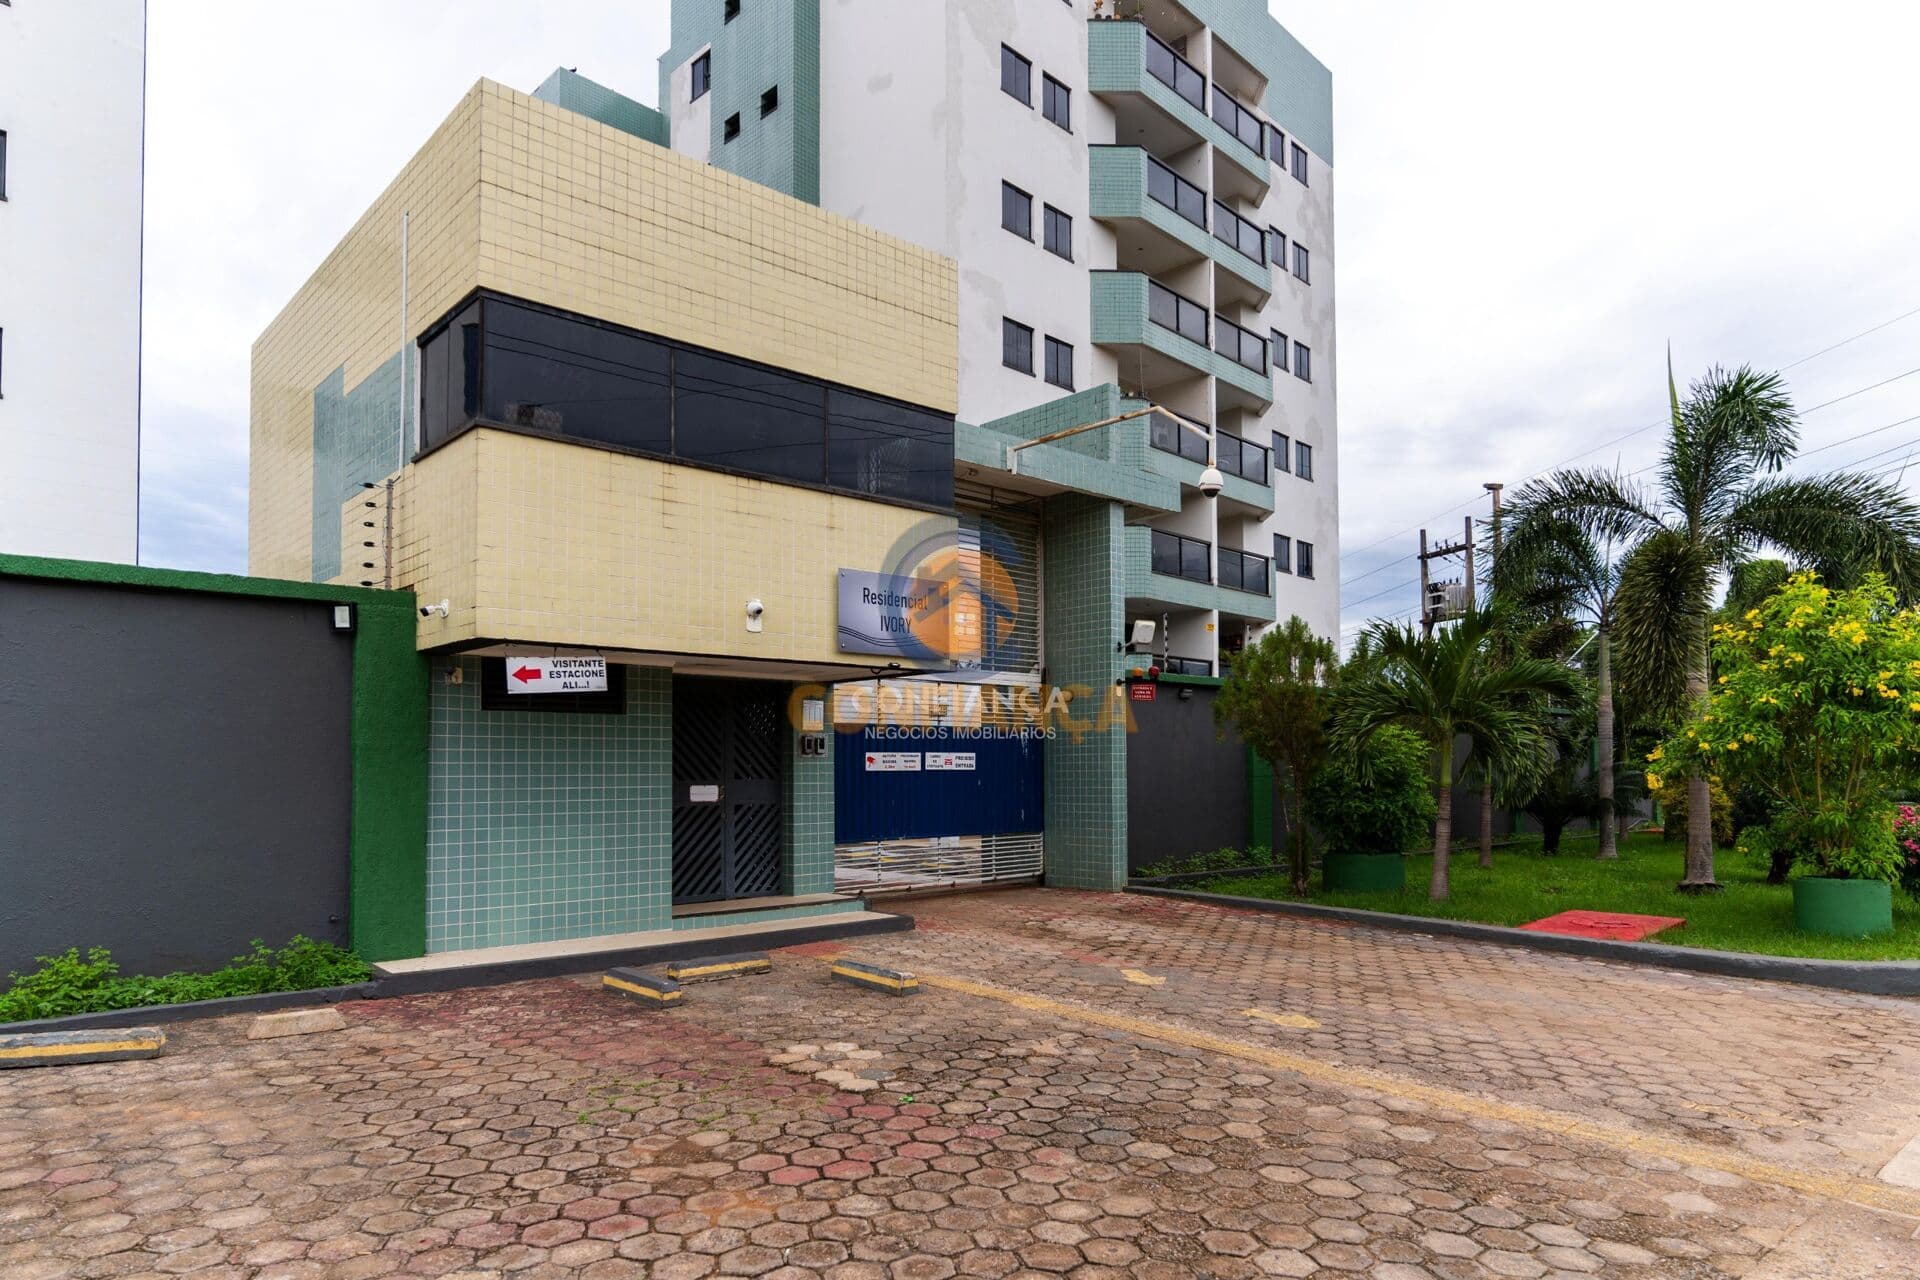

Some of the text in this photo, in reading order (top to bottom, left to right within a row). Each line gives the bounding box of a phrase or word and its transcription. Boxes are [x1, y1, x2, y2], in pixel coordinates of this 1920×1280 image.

[863, 588, 927, 610] Residencial
[880, 615, 912, 633] IVORY
[552, 660, 604, 668] VISITANTE
[549, 670, 604, 678] ESTACIONE
